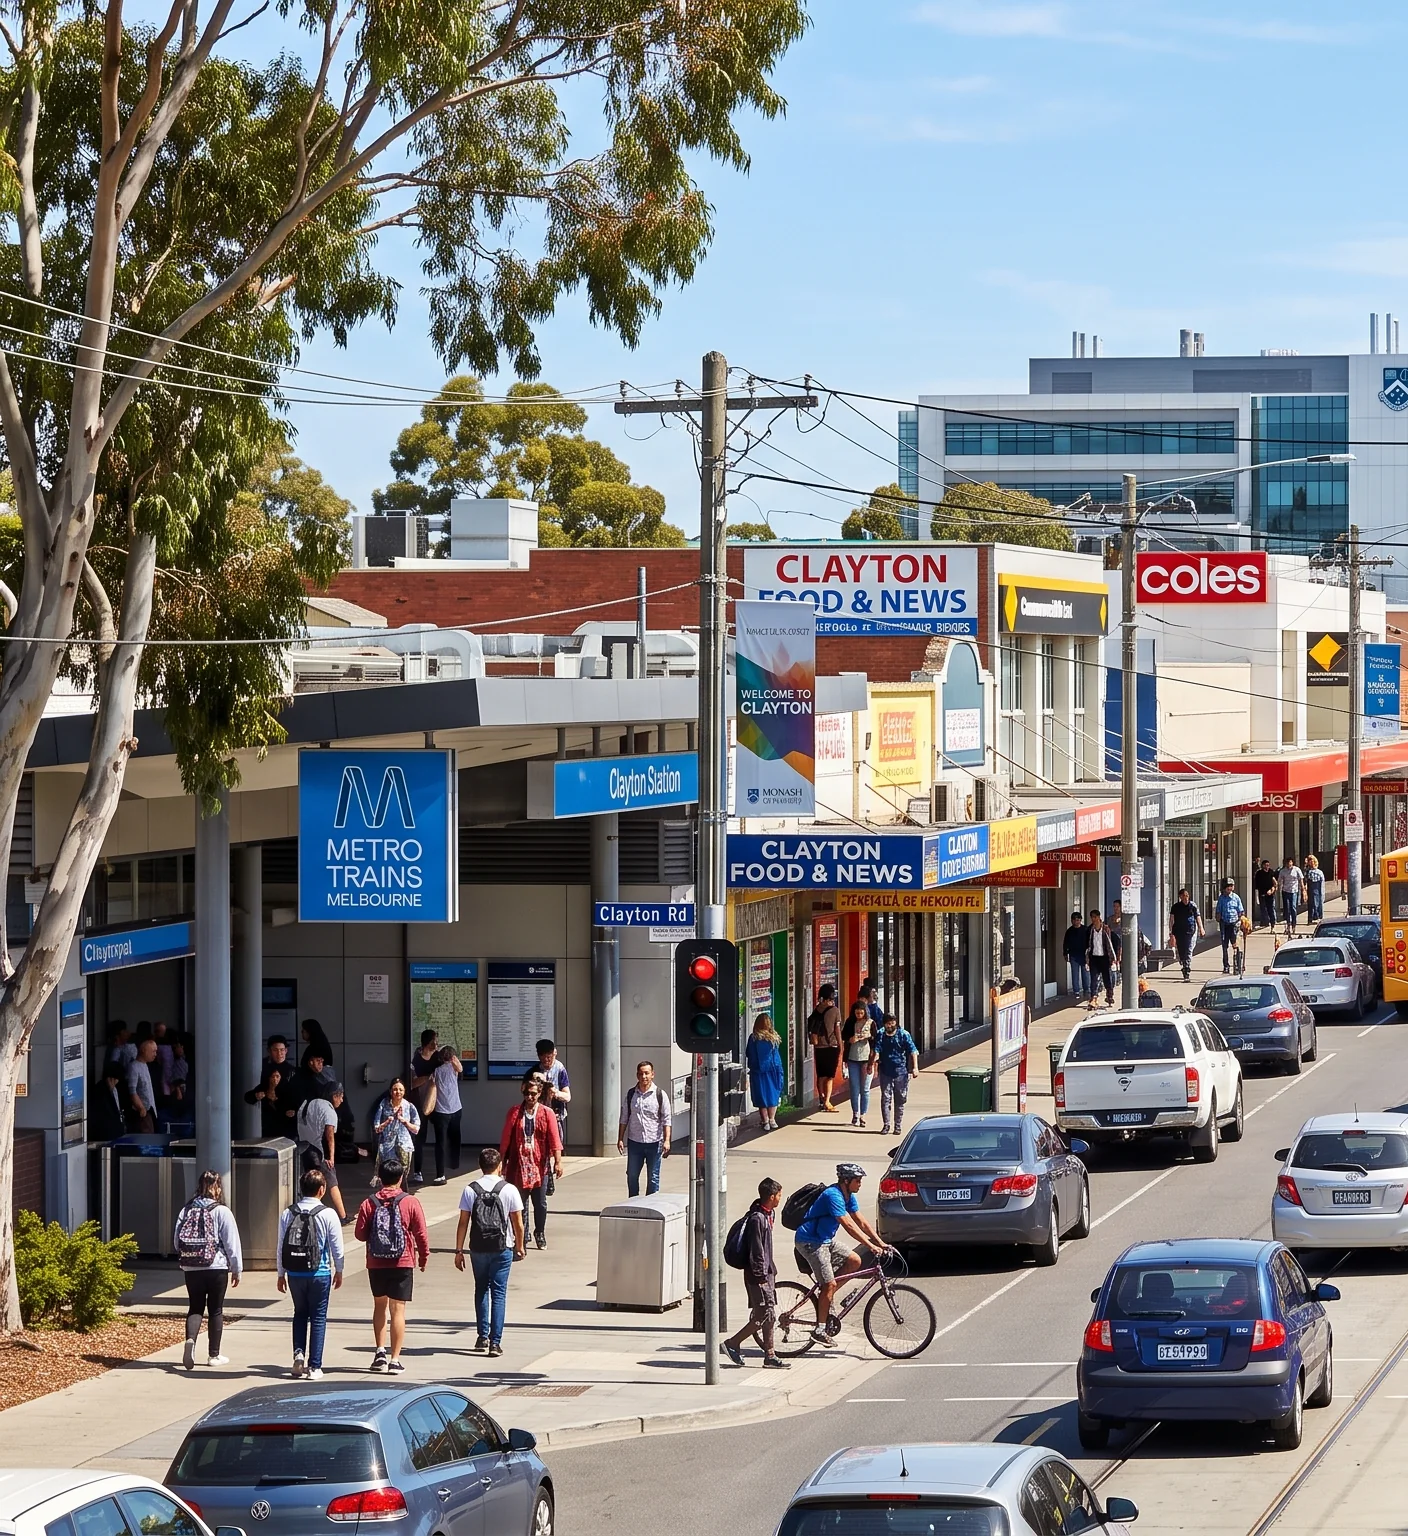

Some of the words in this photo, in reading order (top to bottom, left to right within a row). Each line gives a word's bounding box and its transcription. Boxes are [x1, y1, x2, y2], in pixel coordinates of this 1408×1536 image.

[776, 554, 947, 583] CLAYTON
[1141, 557, 1260, 595] coles
[851, 589, 873, 613] &
[881, 589, 967, 613] NEWS
[741, 690, 794, 699] WELCOME
[796, 689, 811, 699] TO
[740, 701, 812, 715] CLAYTON
[609, 767, 647, 806] Clayton
[647, 764, 681, 796] Station
[762, 788, 803, 797] MONASH
[327, 838, 423, 862] METRO
[761, 841, 881, 860] CLAYTON
[326, 865, 423, 889] TRAINS
[731, 863, 805, 883] FOOD
[811, 863, 828, 883] &
[836, 864, 913, 883] NEWS
[327, 893, 422, 907] MELBOURNE
[600, 906, 660, 925] Clayton
[668, 906, 687, 922] Rd
